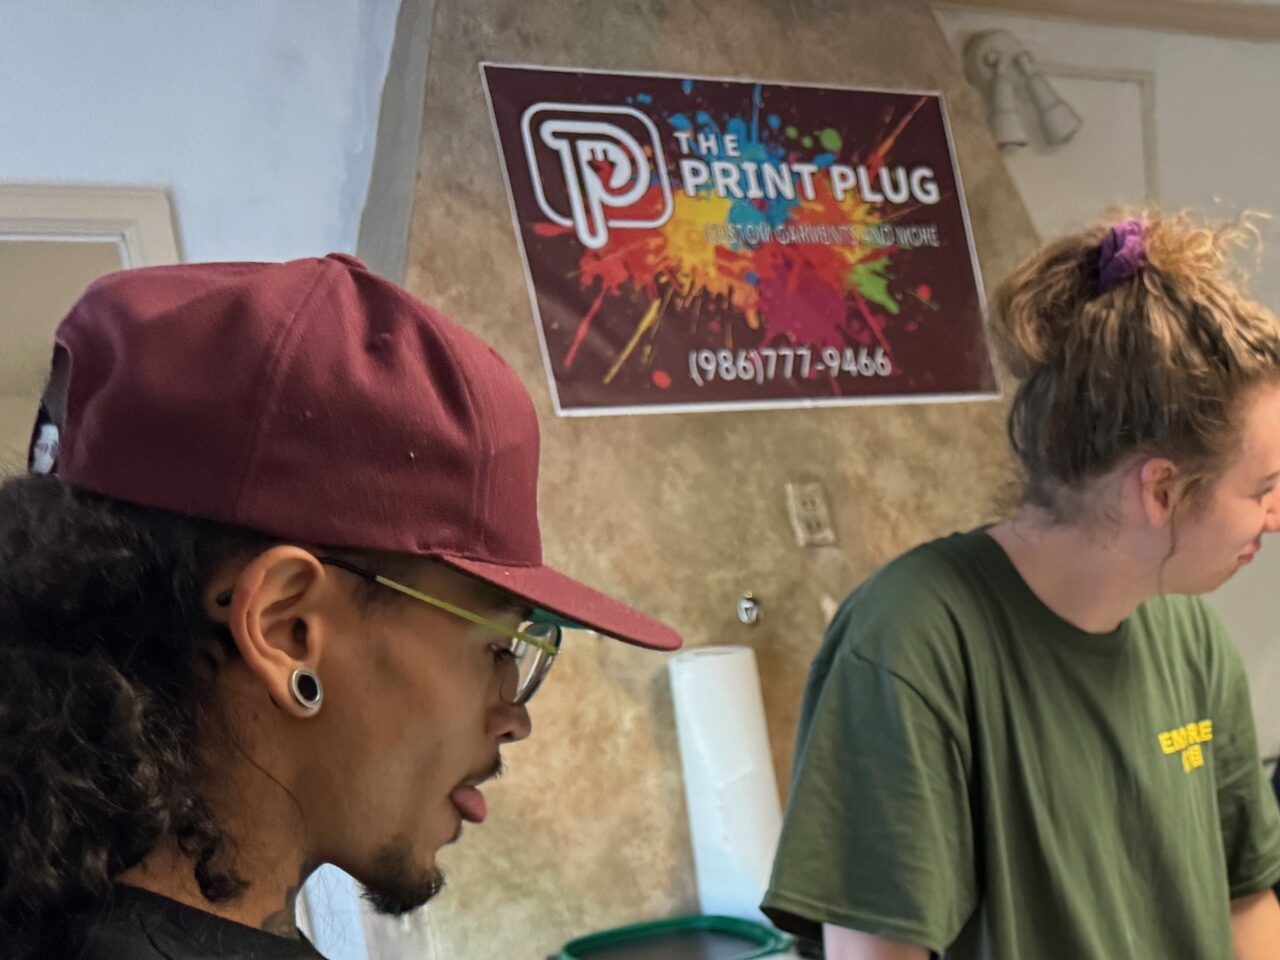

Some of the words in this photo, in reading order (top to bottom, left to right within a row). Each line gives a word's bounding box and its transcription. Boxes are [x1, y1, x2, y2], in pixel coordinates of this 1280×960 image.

[673, 131, 741, 157] THE
[680, 158, 818, 200] PRINT
[829, 164, 941, 205] PLUG
[688, 345, 893, 388] (986)777-9466
